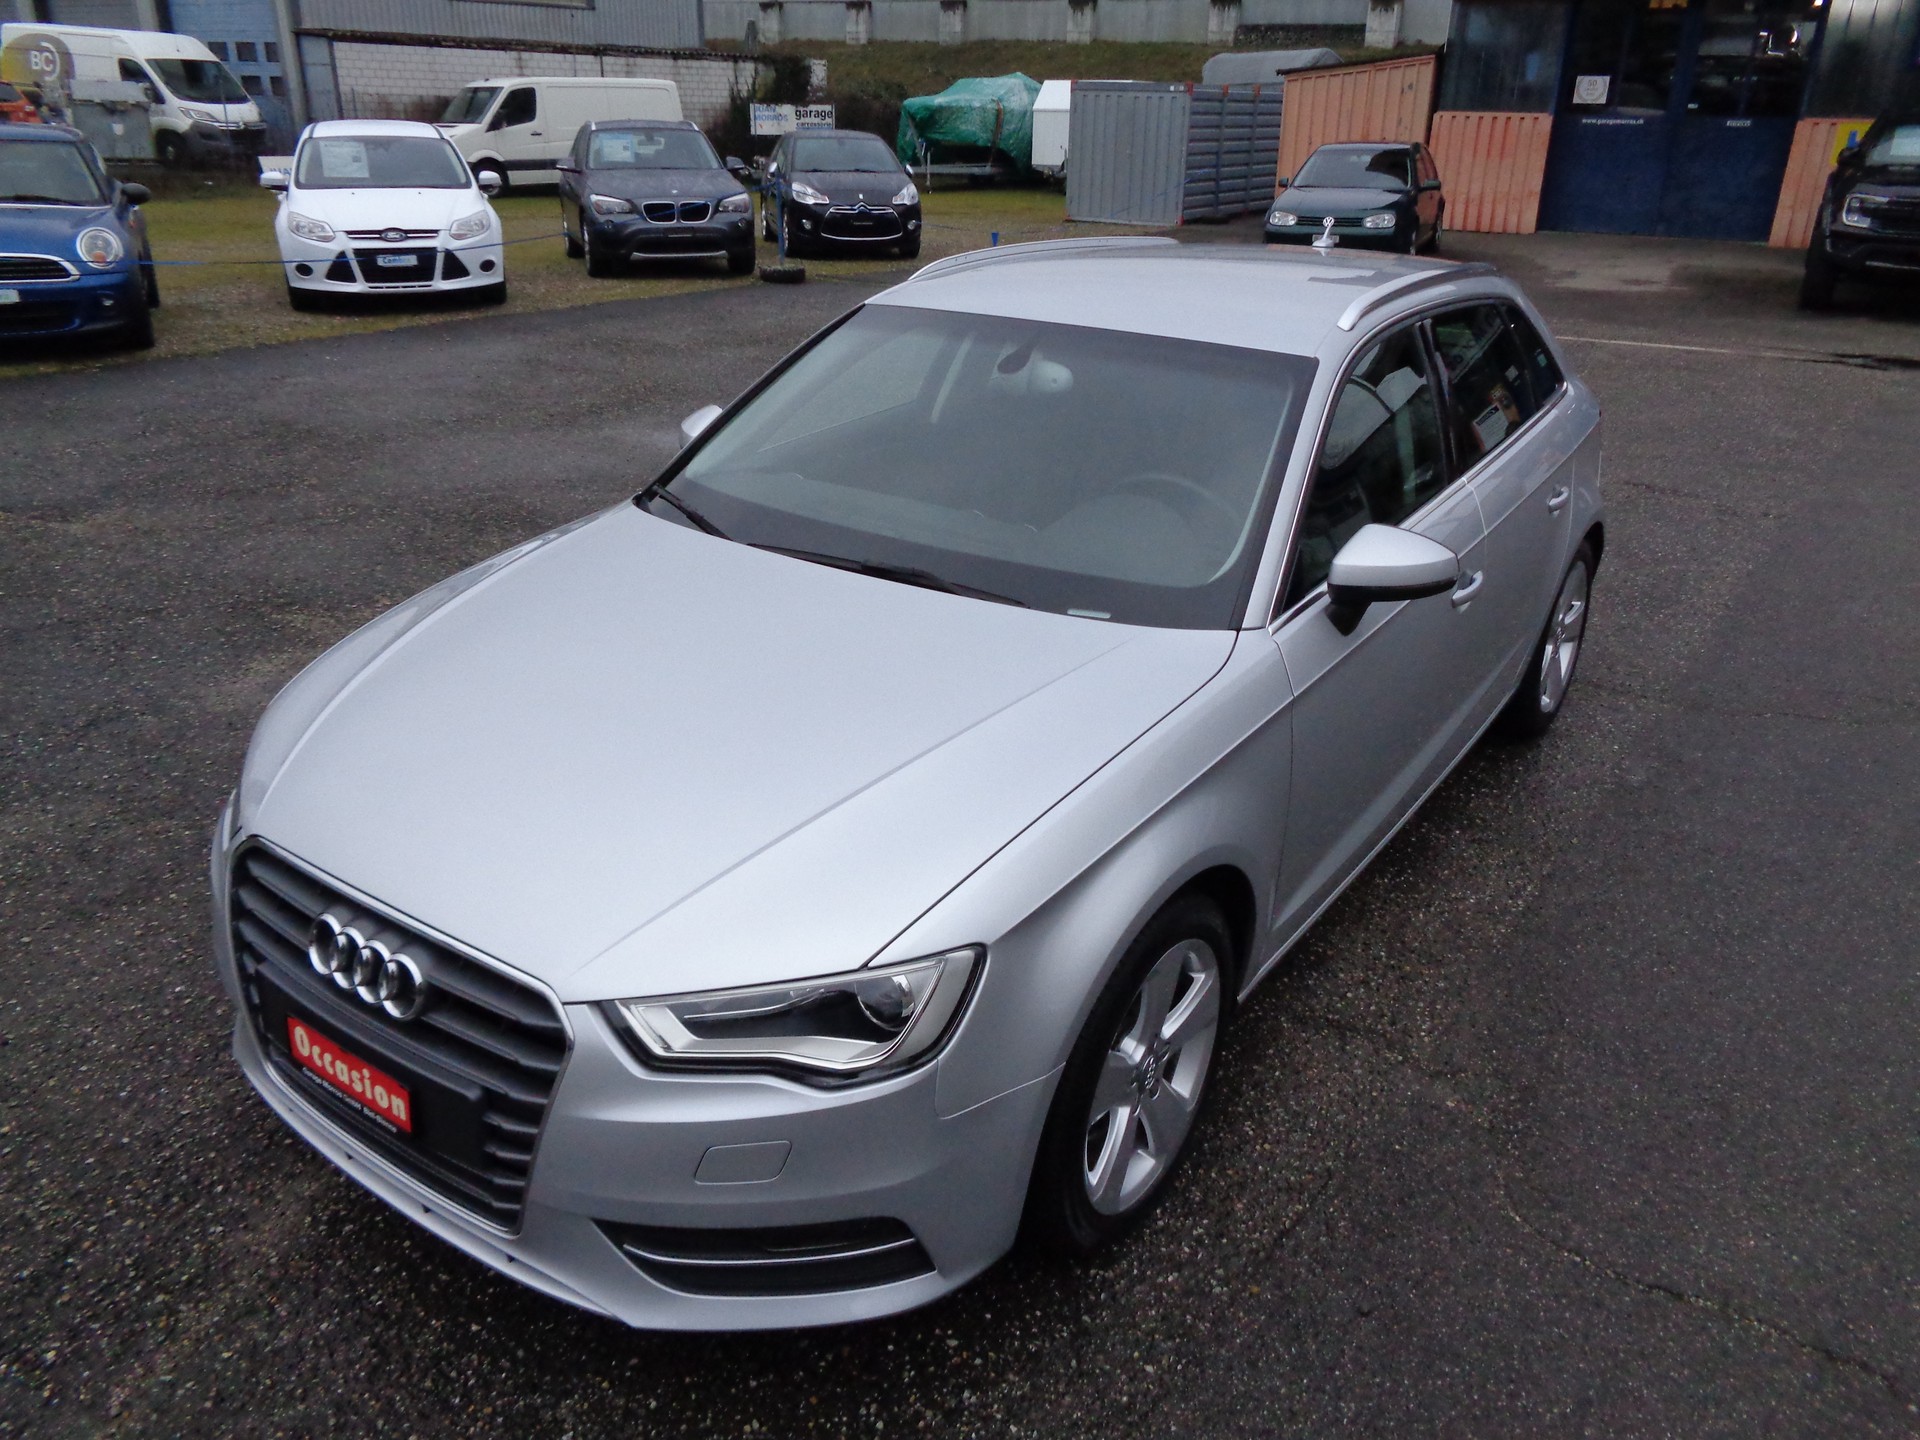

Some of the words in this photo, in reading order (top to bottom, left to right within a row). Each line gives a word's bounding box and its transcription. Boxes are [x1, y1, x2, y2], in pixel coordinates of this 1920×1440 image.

[30, 50, 54, 72] BC
[795, 109, 833, 120] garage
[294, 1025, 407, 1122] Occasion
